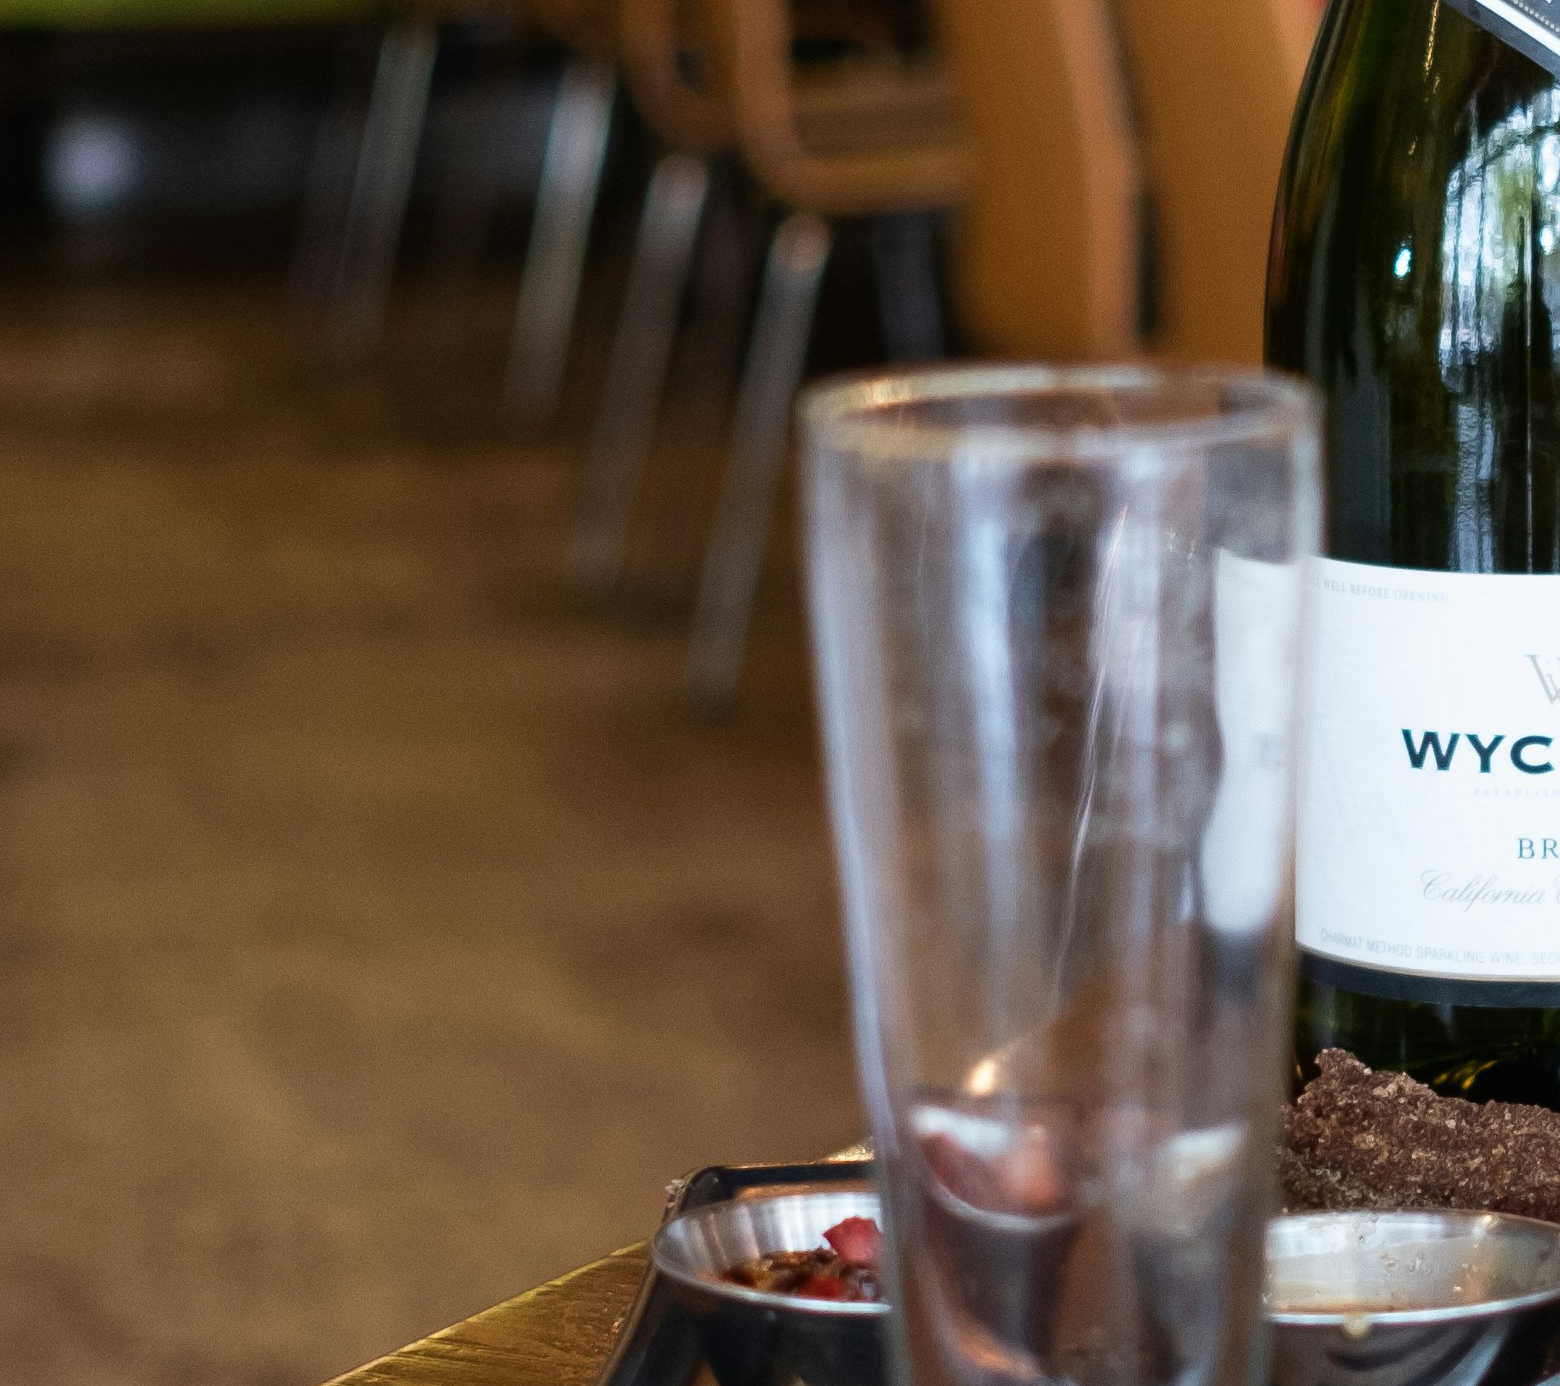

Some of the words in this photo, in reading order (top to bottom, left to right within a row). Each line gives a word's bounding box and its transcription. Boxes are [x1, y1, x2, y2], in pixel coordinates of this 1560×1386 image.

[1350, 584, 1390, 600] BEFORE
[1394, 588, 1449, 604] OPENING
[1420, 869, 1546, 912] California
[1367, 940, 1412, 960] METHOD
[1416, 946, 1486, 964] SPARKLING
